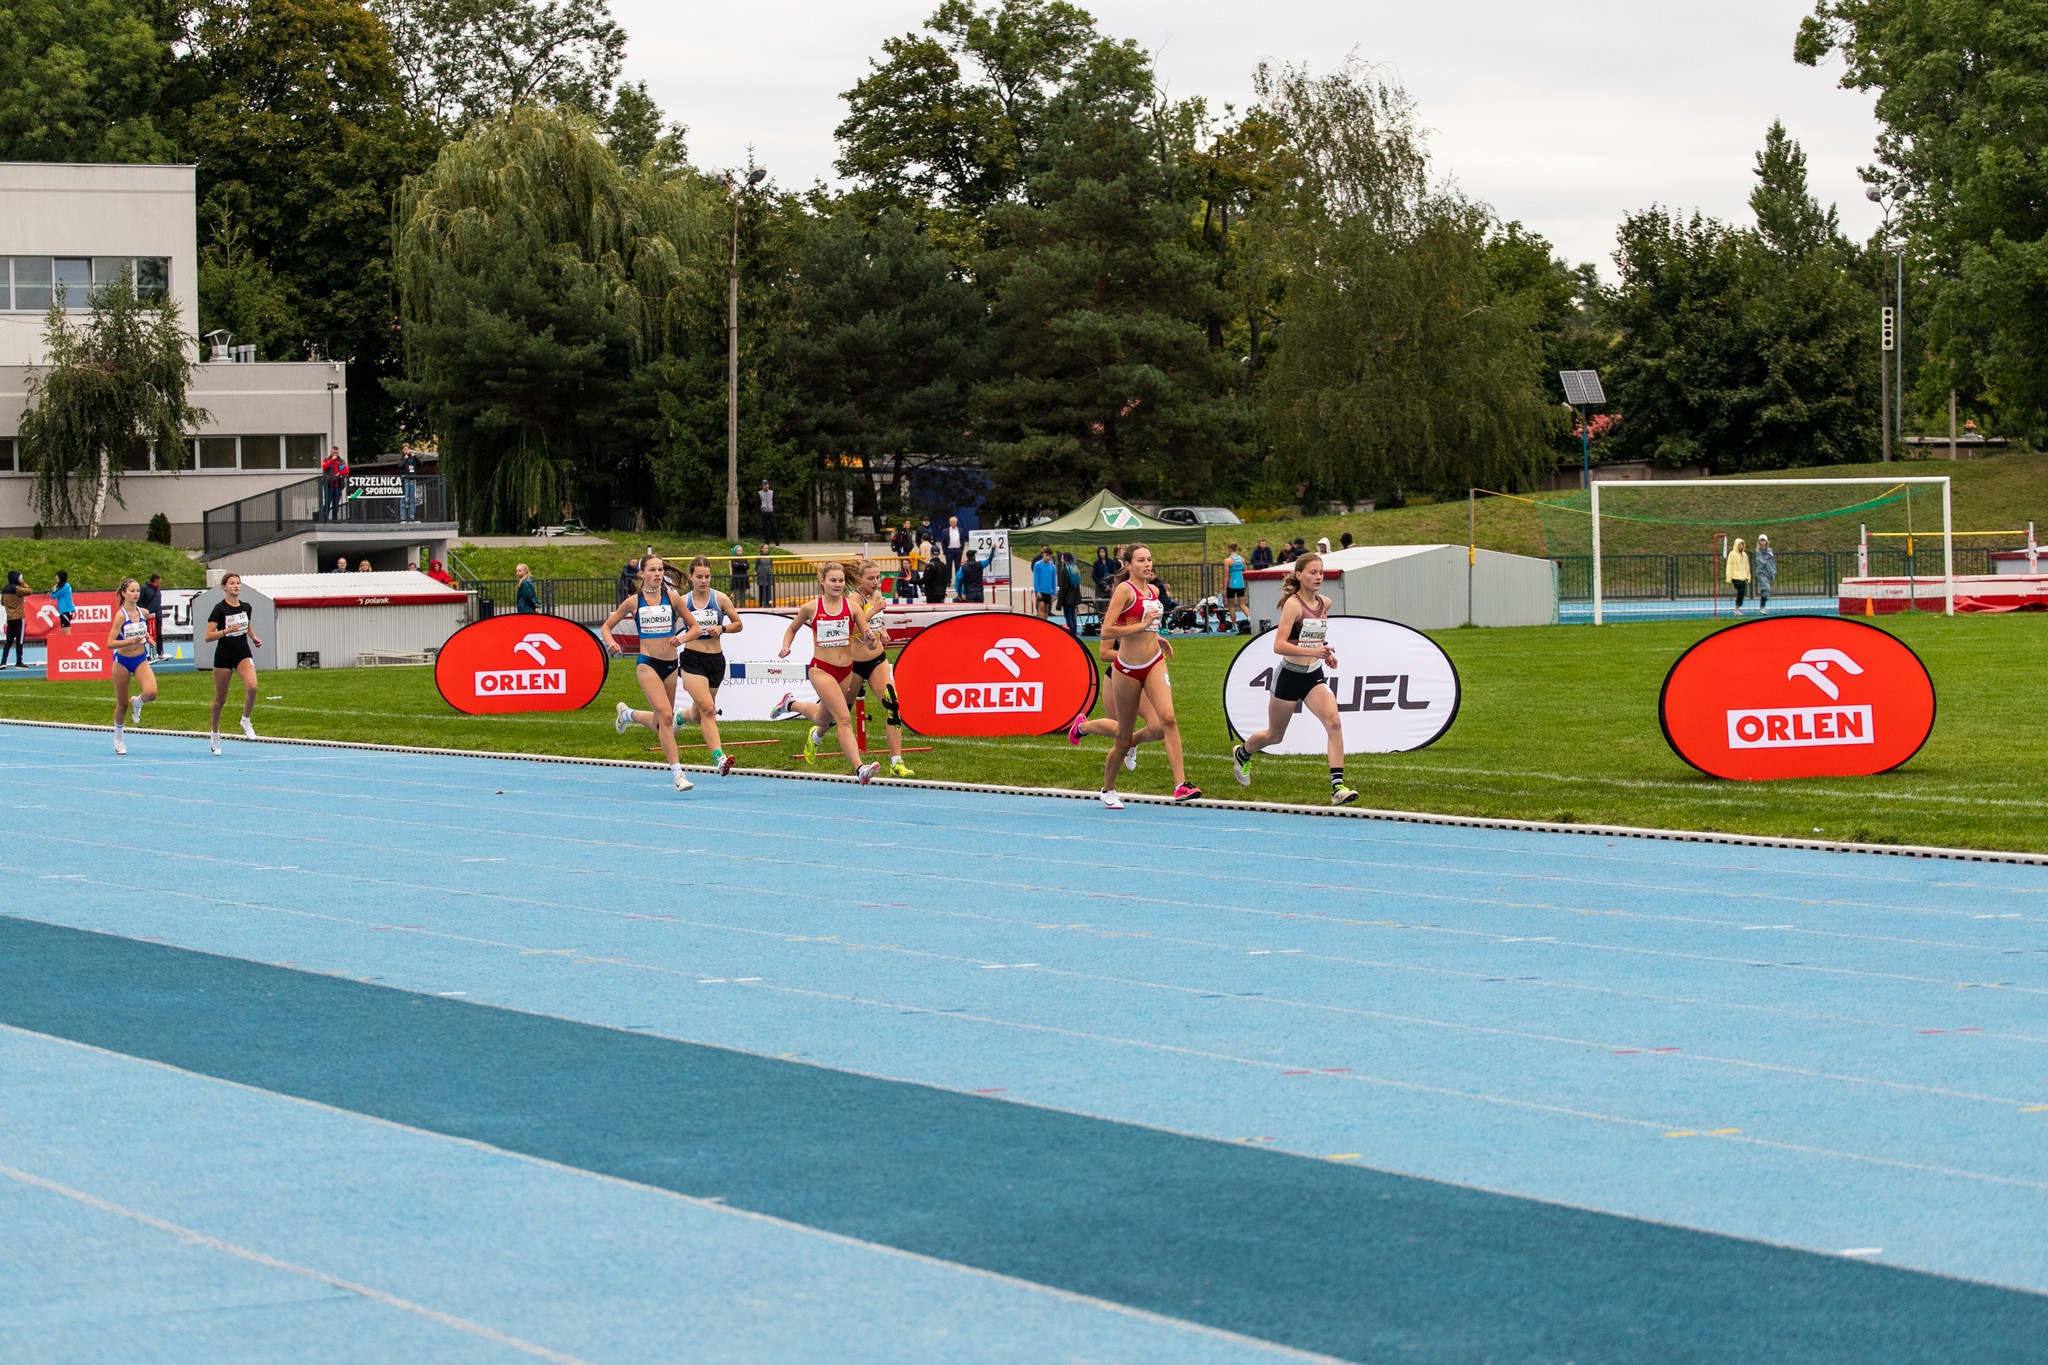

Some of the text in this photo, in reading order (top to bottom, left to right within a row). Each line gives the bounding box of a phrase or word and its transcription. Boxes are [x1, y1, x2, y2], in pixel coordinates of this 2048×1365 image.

[348, 476, 402, 487] STRZELNICA
[365, 487, 403, 495] SPORTOWA
[836, 620, 846, 628] 27
[1320, 620, 1327, 628] 32
[826, 630, 840, 638] ŻUK
[62, 661, 99, 670] ORLEN
[480, 673, 560, 692] ORLEN
[1249, 667, 1431, 713] 4UEL
[942, 687, 1036, 709] ORLEN
[1735, 711, 1864, 743] ORLEN
